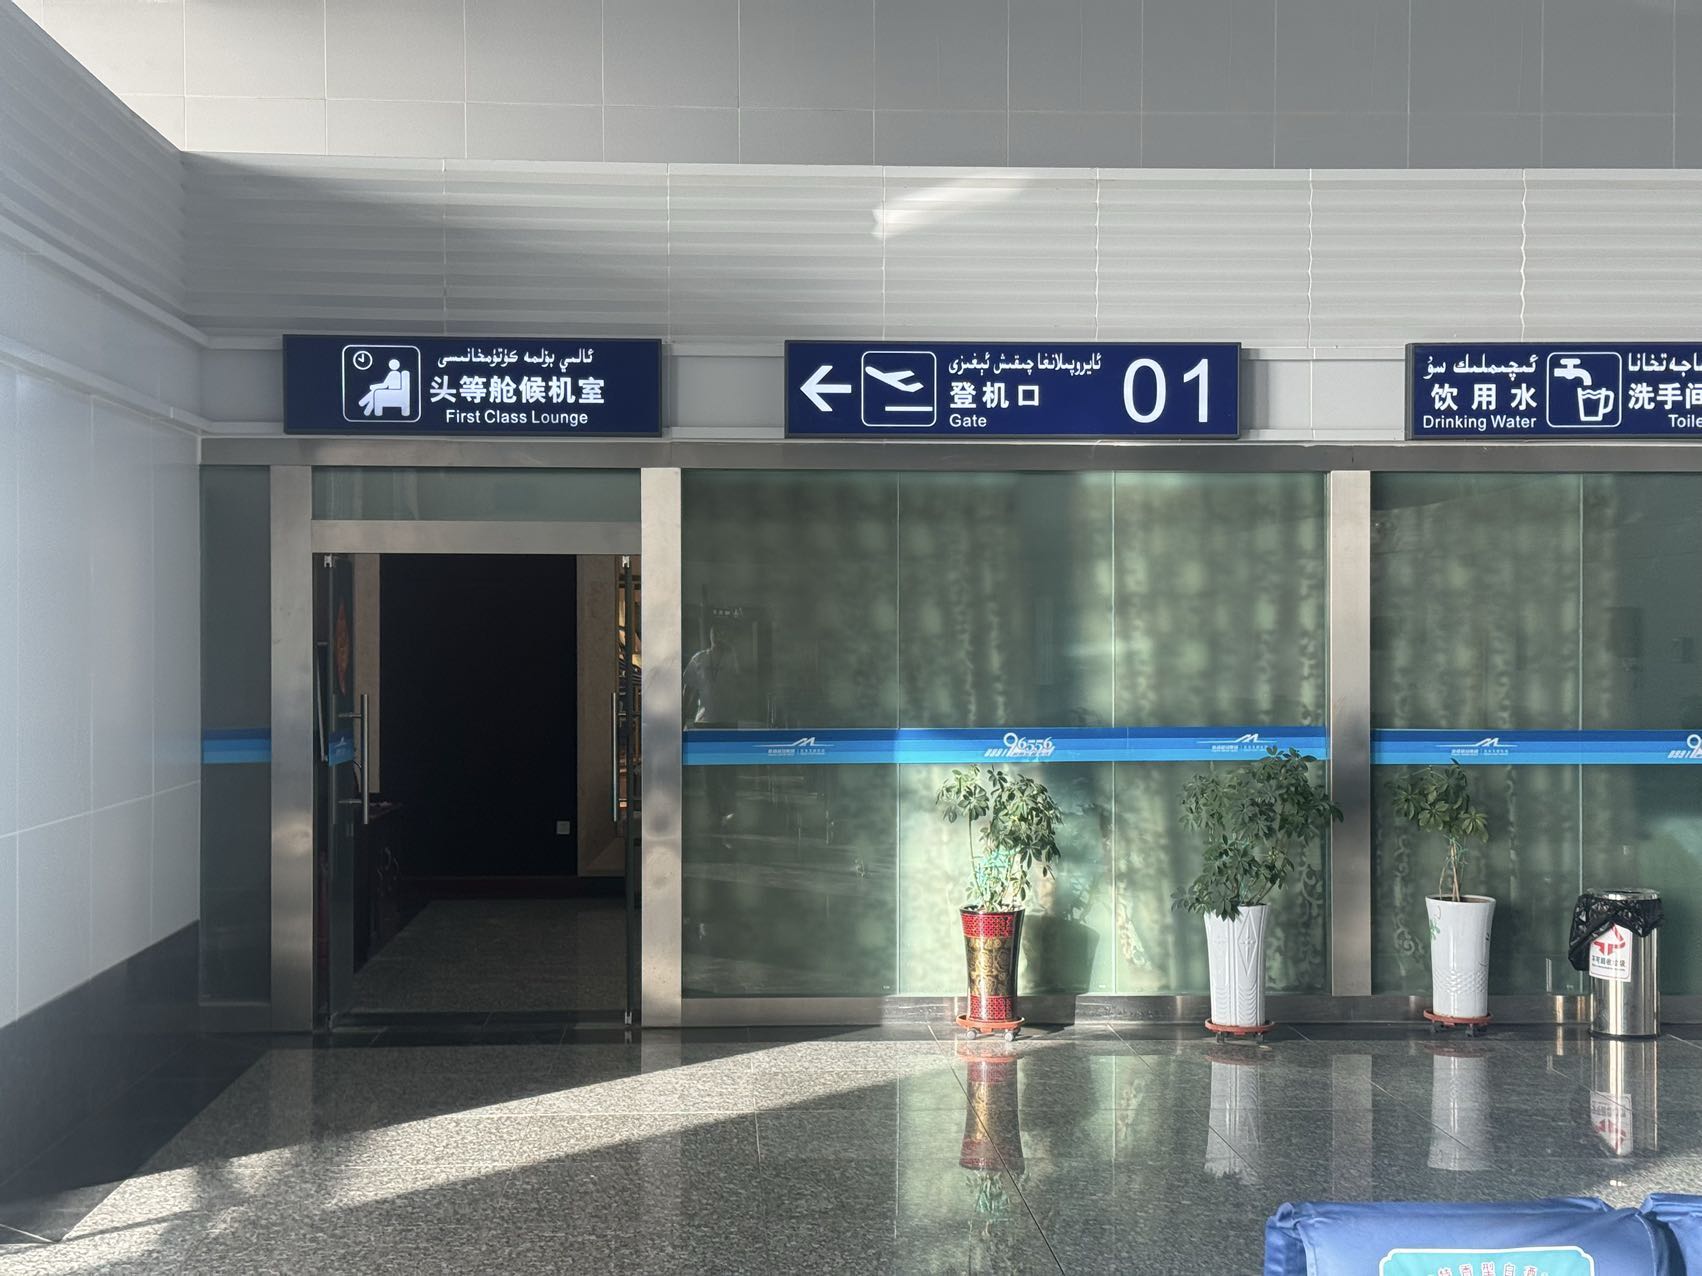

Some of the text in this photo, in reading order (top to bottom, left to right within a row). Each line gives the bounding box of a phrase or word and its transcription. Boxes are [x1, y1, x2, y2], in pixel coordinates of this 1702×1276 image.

[1628, 352, 1702, 378] اجەتخانا
[429, 375, 605, 404] 头等舱候机室
[949, 381, 1040, 409] 登机口
[1123, 357, 1209, 424] 01
[1430, 382, 1538, 411] 饮用水
[1628, 382, 1702, 410] 洗手间
[445, 409, 588, 427] First Class Lounge
[949, 413, 987, 428] Gate
[1423, 414, 1537, 432] Drinking Water
[1667, 414, 1702, 428] Toile
